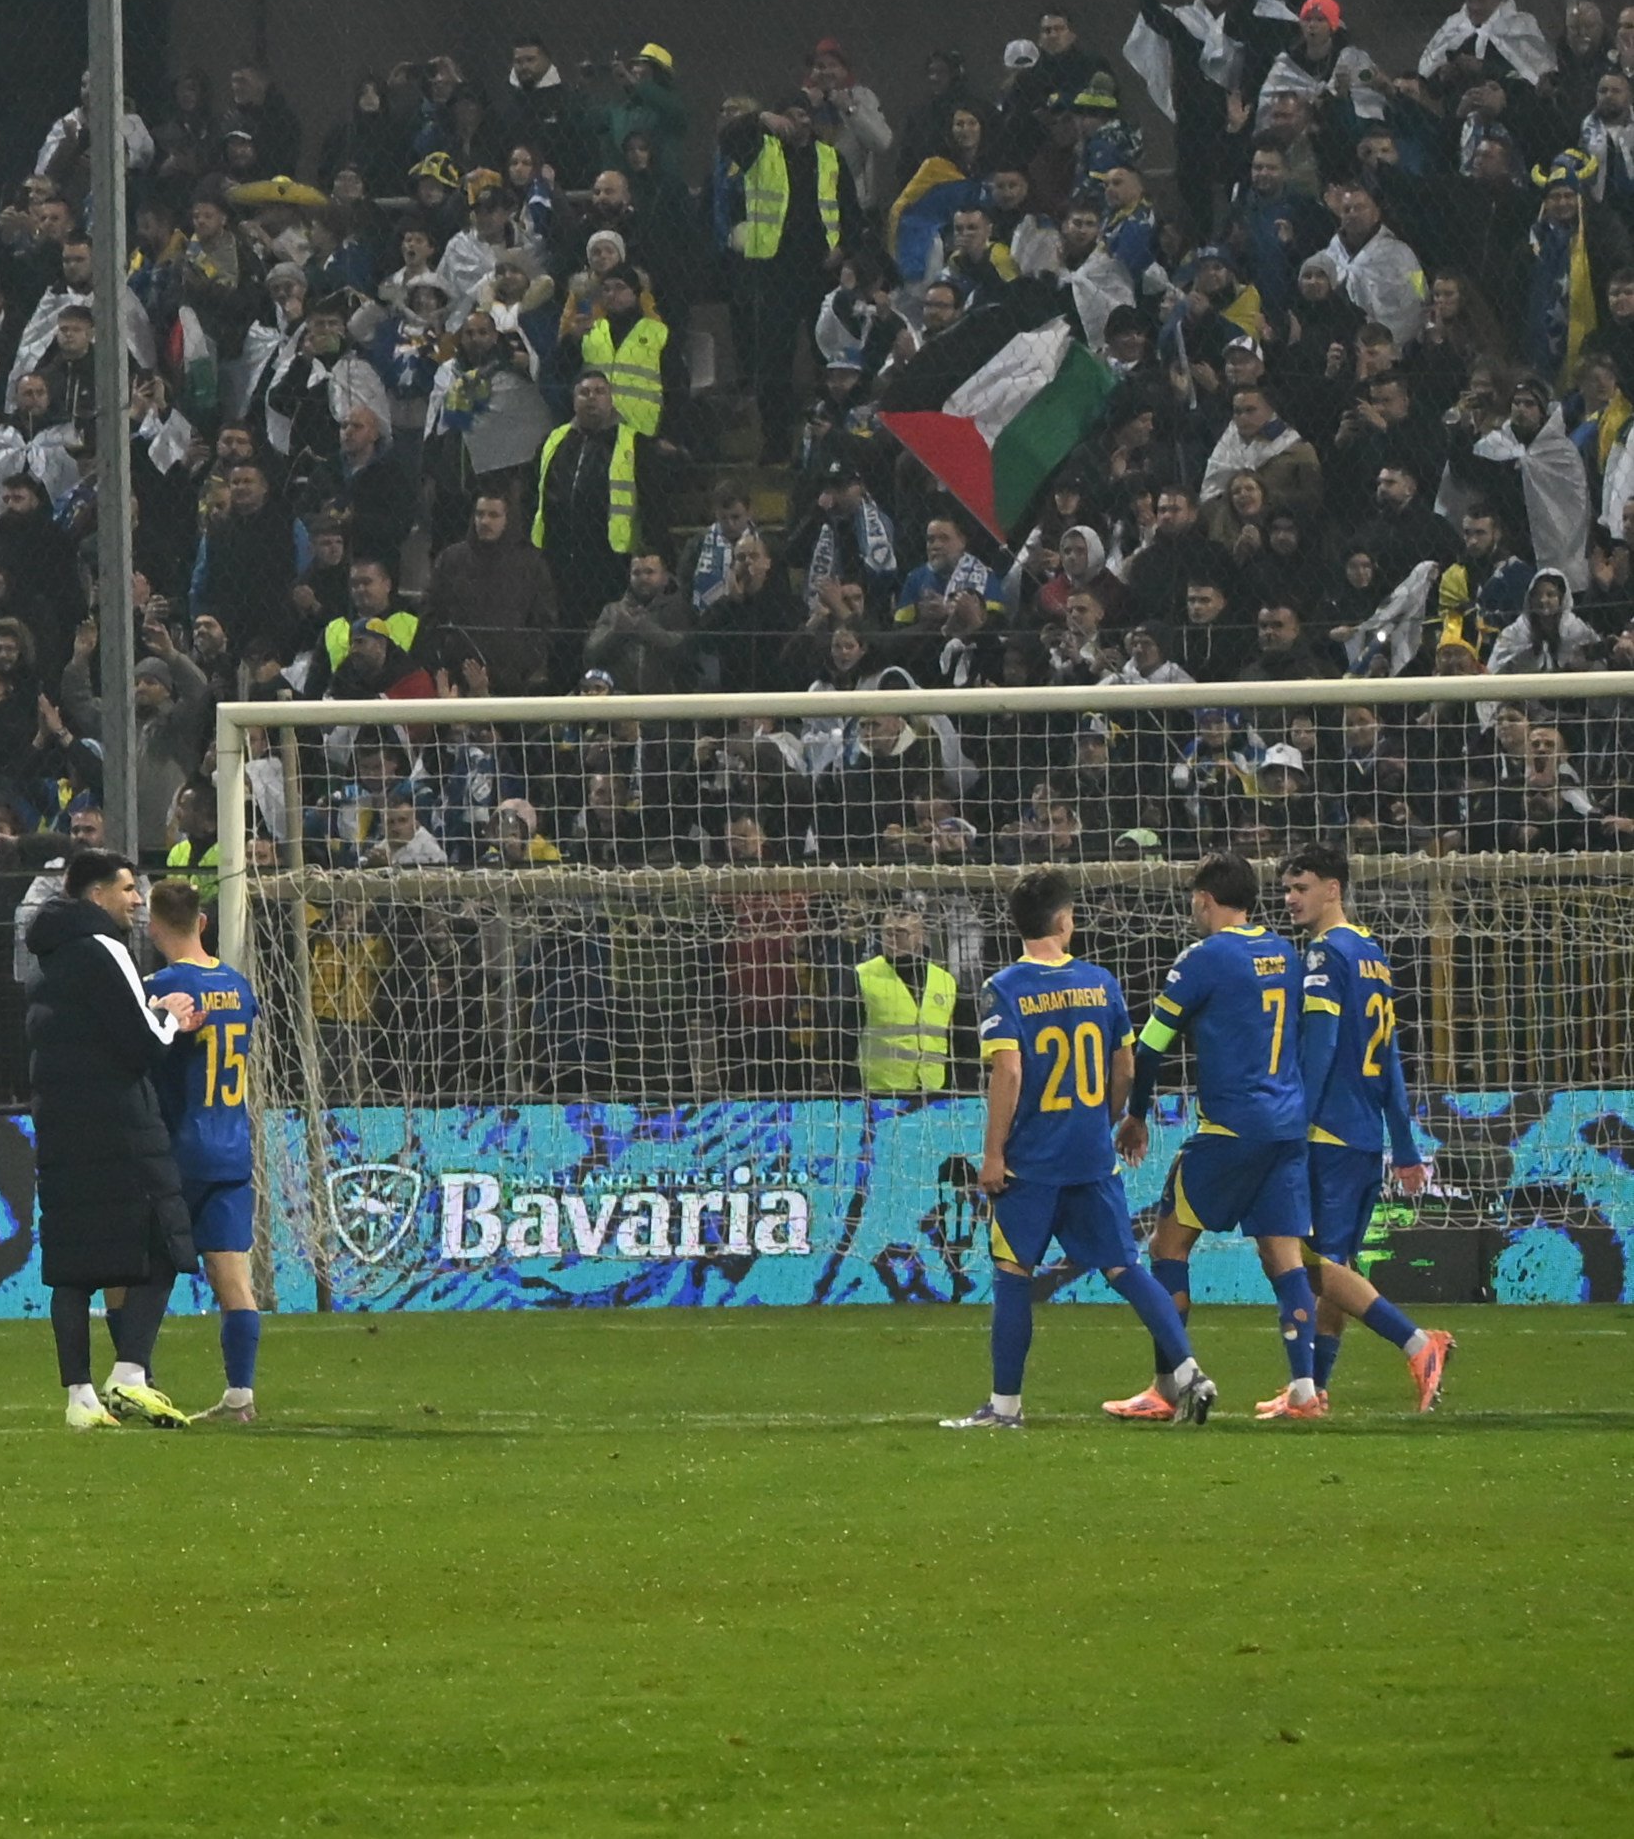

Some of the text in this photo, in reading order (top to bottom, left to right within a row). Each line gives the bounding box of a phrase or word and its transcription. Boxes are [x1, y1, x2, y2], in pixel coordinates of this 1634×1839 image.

[196, 1023, 247, 1107] 15
[1035, 1021, 1104, 1112] 20
[1262, 988, 1286, 1075] 7
[441, 1172, 811, 1259] Bavaria
